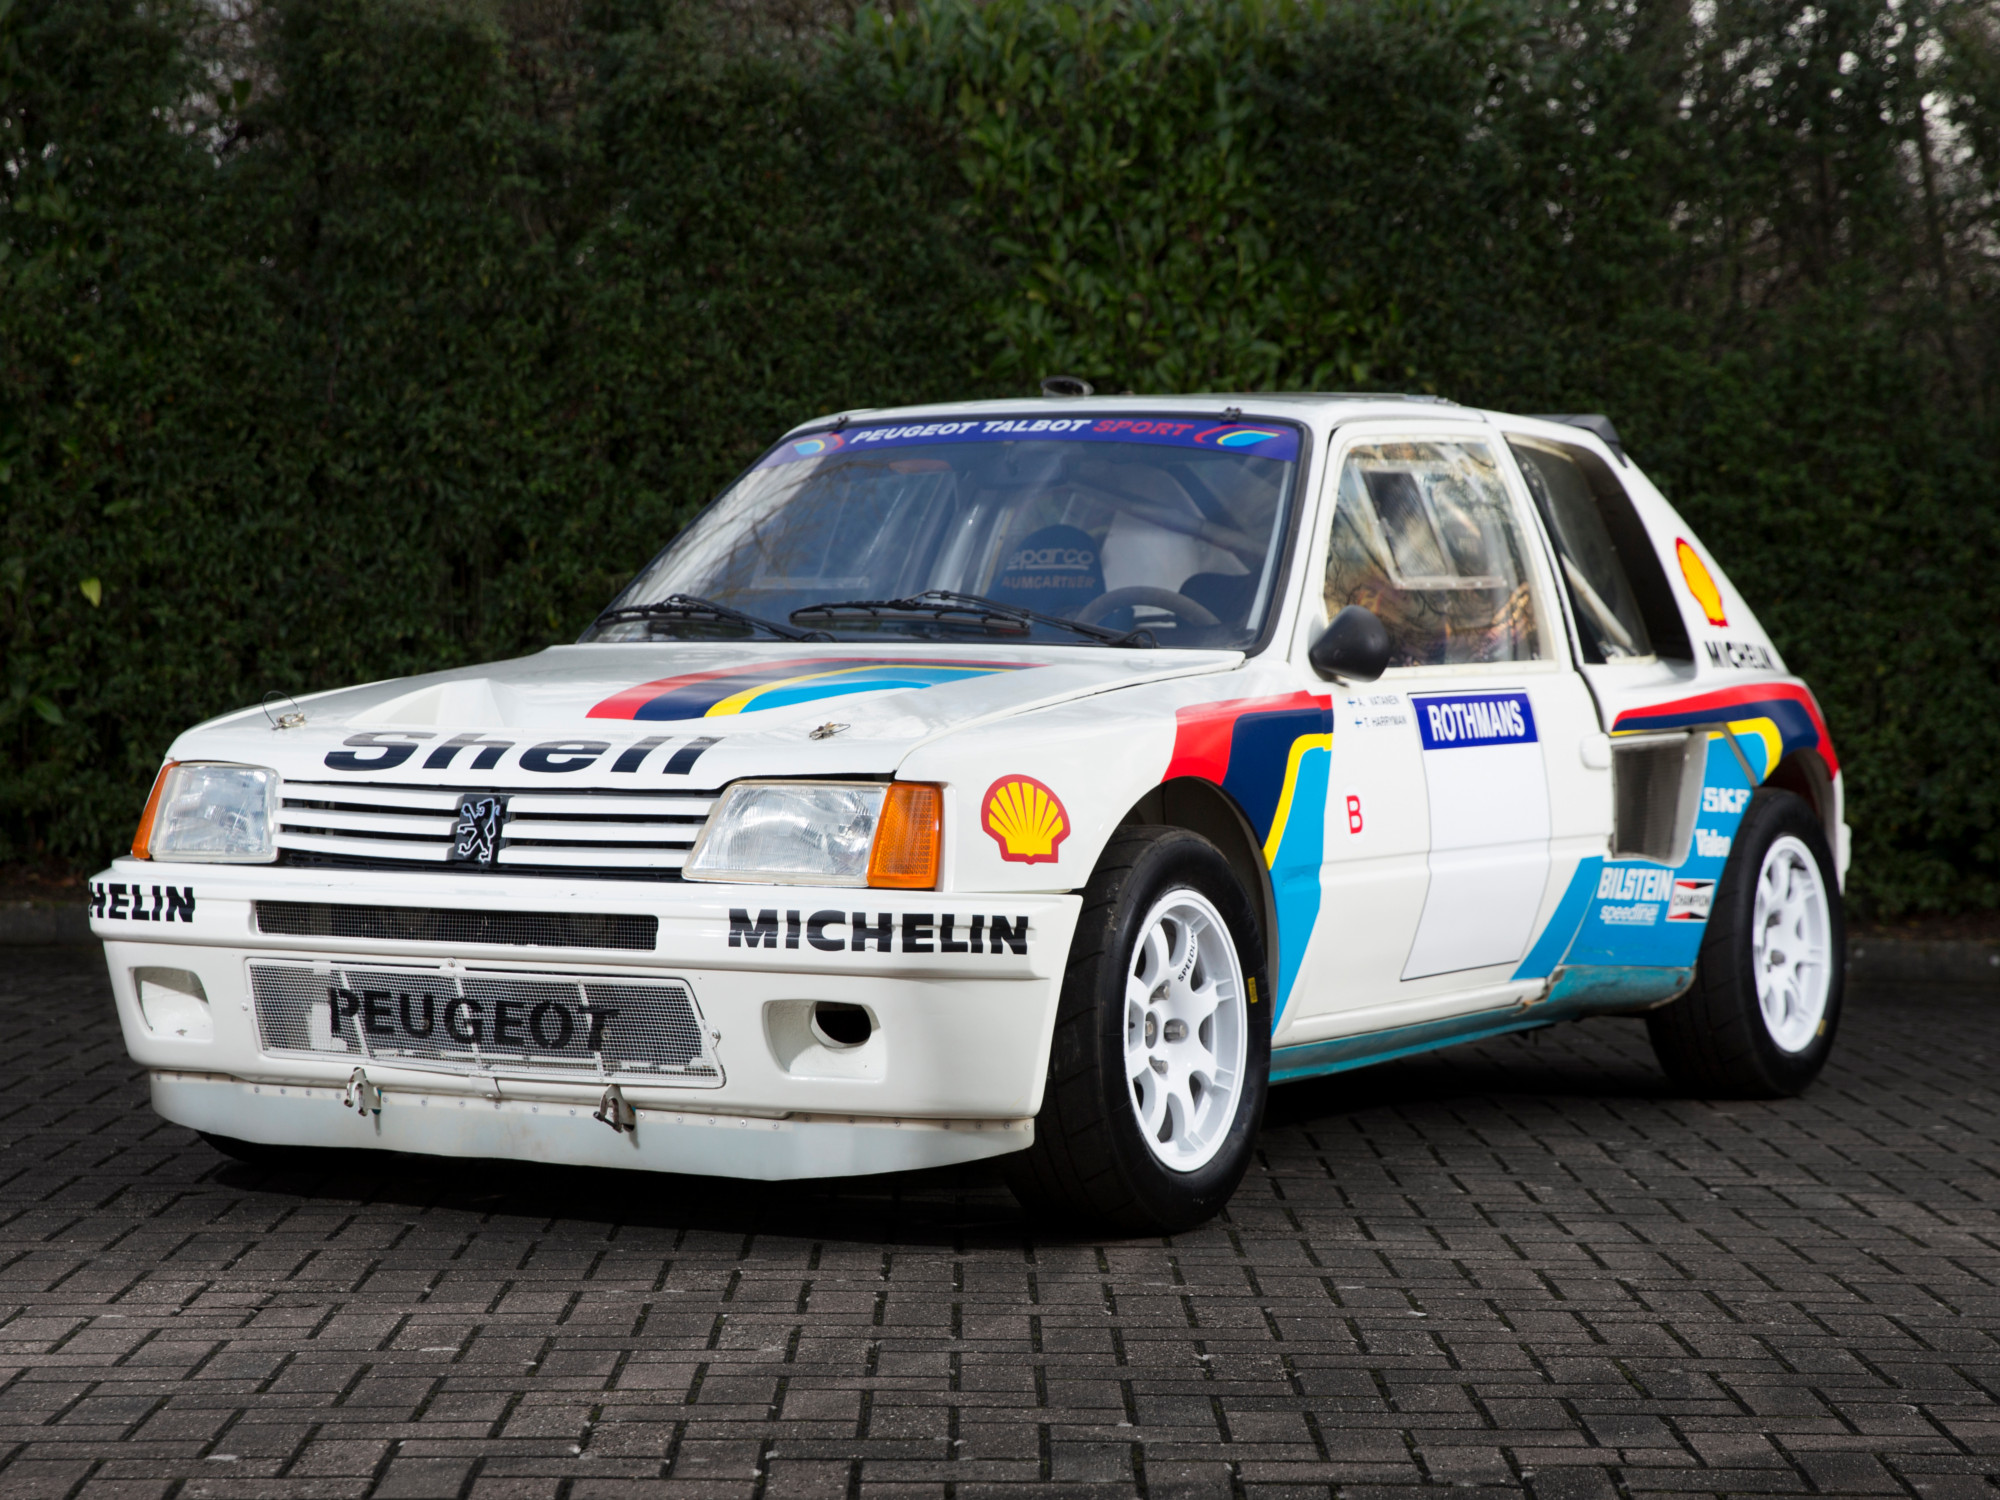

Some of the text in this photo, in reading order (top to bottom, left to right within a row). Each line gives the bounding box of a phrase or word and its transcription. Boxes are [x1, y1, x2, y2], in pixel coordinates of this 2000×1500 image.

[850, 419, 1195, 444] PEUGEOT TALBOT SPORT
[1427, 700, 1526, 742] ROTHMANS
[324, 732, 727, 775] Shell
[1346, 795, 1364, 834] B
[1703, 786, 1751, 813] SKF
[1597, 867, 1674, 901] BILSTEIN
[728, 908, 1029, 955] MICHELIN
[329, 988, 621, 1051] PEUGEOT
